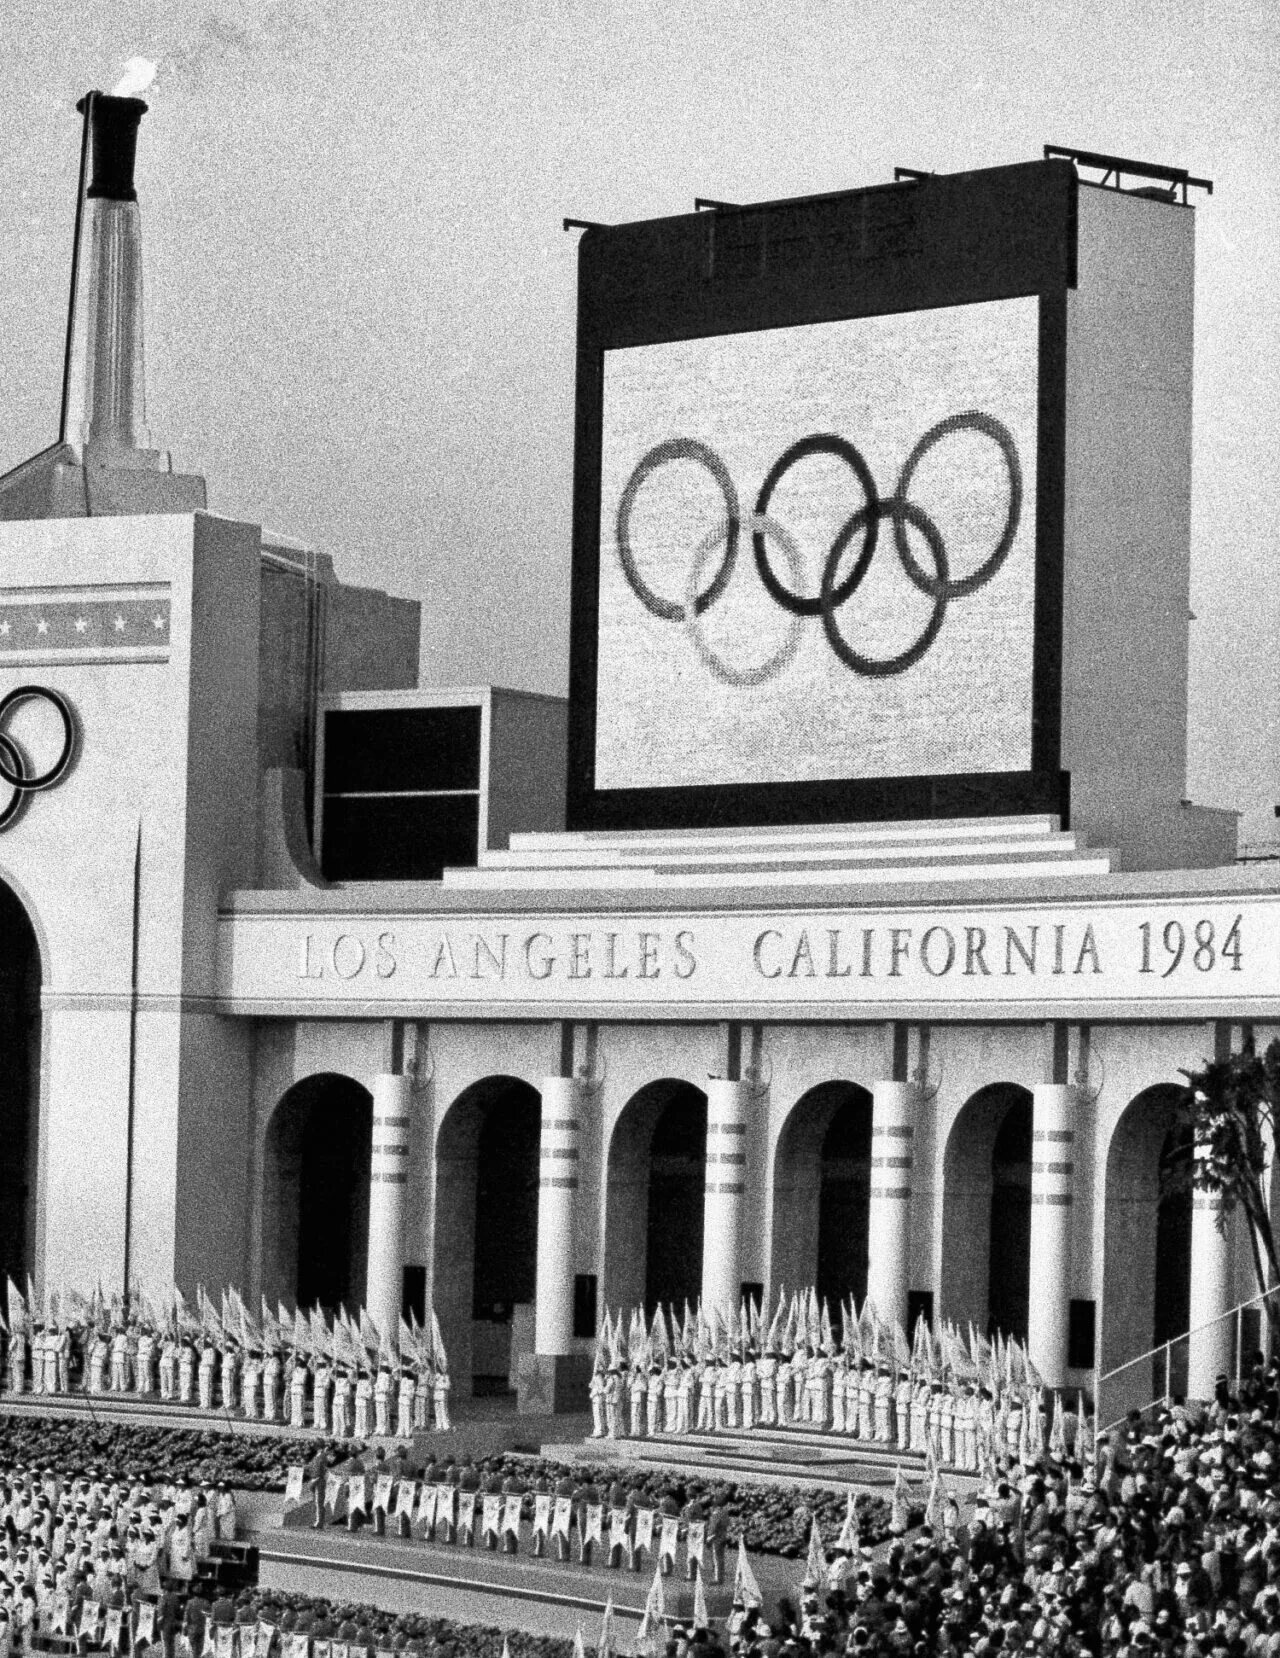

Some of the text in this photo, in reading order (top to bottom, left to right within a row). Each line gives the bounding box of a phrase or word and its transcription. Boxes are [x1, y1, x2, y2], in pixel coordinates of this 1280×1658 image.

[298, 913, 1245, 980] LOS ANGELES CALIFORNIA 1984
